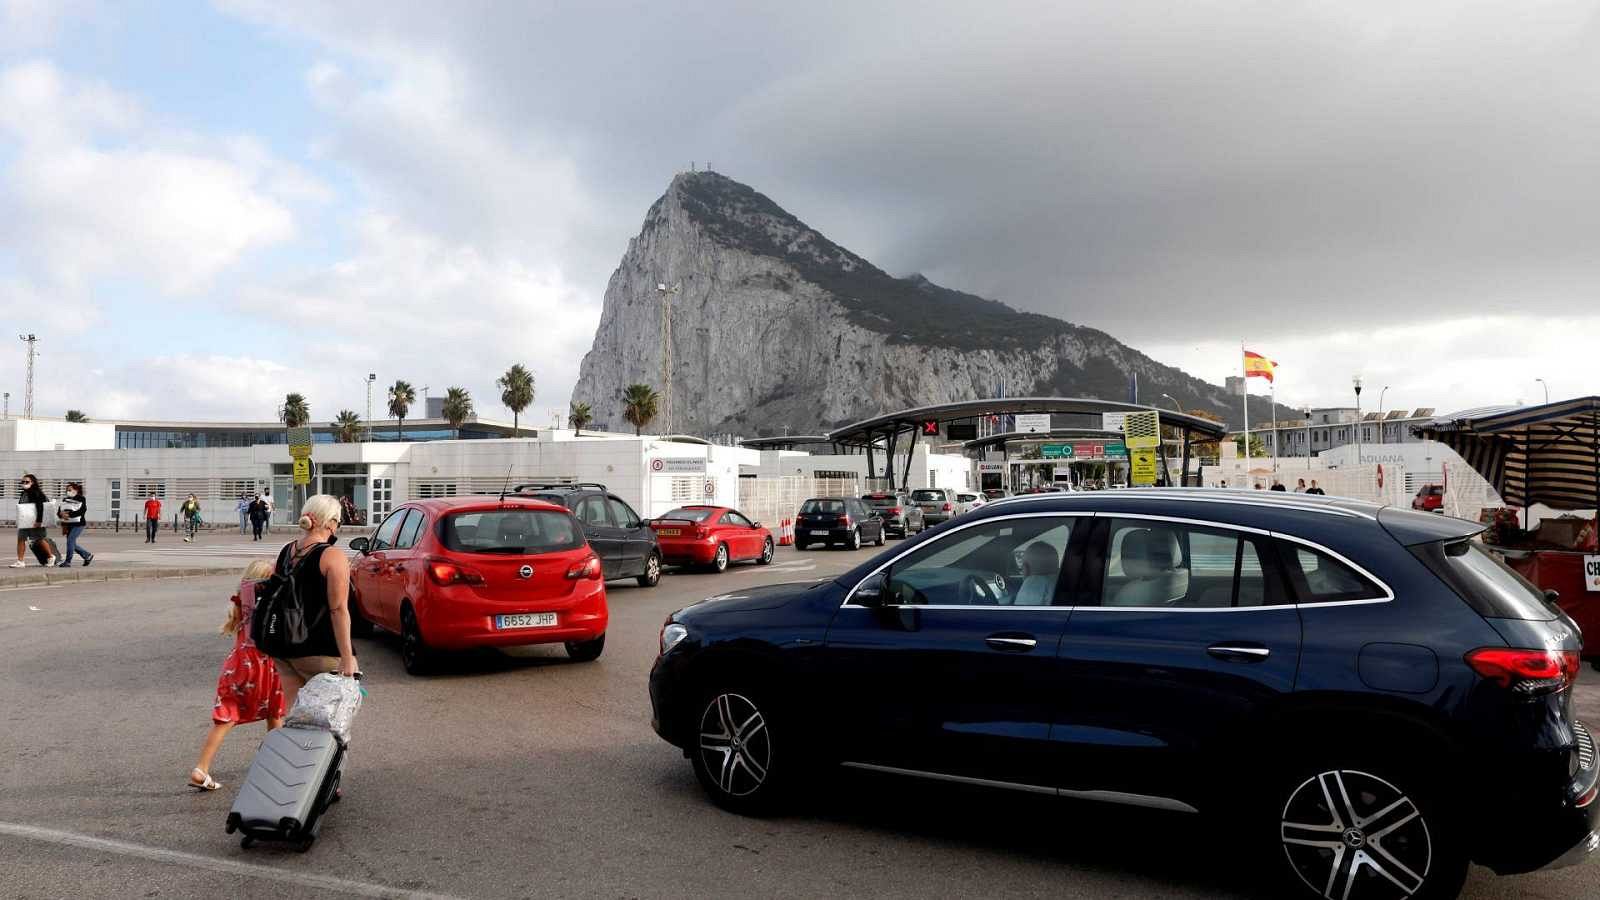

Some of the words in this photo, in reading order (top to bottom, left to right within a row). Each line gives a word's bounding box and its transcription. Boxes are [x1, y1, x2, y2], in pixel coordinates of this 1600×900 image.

[1360, 455, 1405, 463] ADUANA
[504, 615, 532, 627] 6652
[537, 614, 555, 625] JHP
